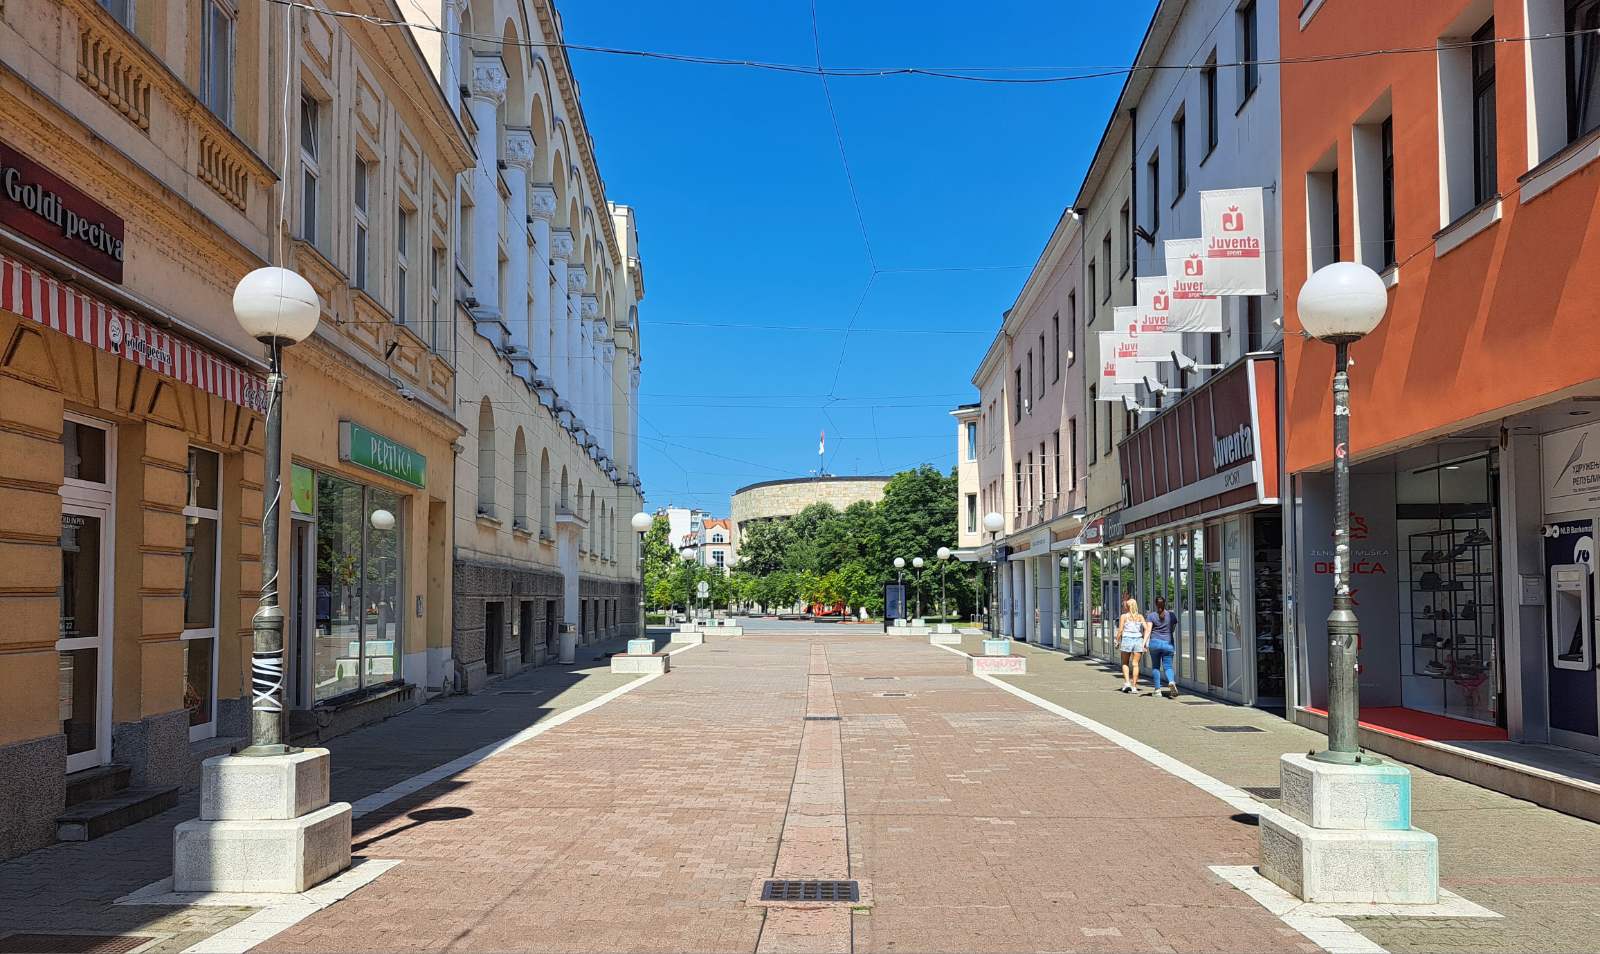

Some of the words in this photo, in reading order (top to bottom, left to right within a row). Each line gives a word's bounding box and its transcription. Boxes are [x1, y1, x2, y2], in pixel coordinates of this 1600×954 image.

[5, 167, 63, 227] Goldi
[65, 209, 124, 261] peciva
[1209, 236, 1259, 248] Juventa
[1142, 315, 1168, 324] Juve
[125, 333, 146, 353] Goldi
[1119, 342, 1137, 351] Juv
[1213, 424, 1253, 470] Juventa
[1573, 474, 1600, 486] РЕПУБЛИ
